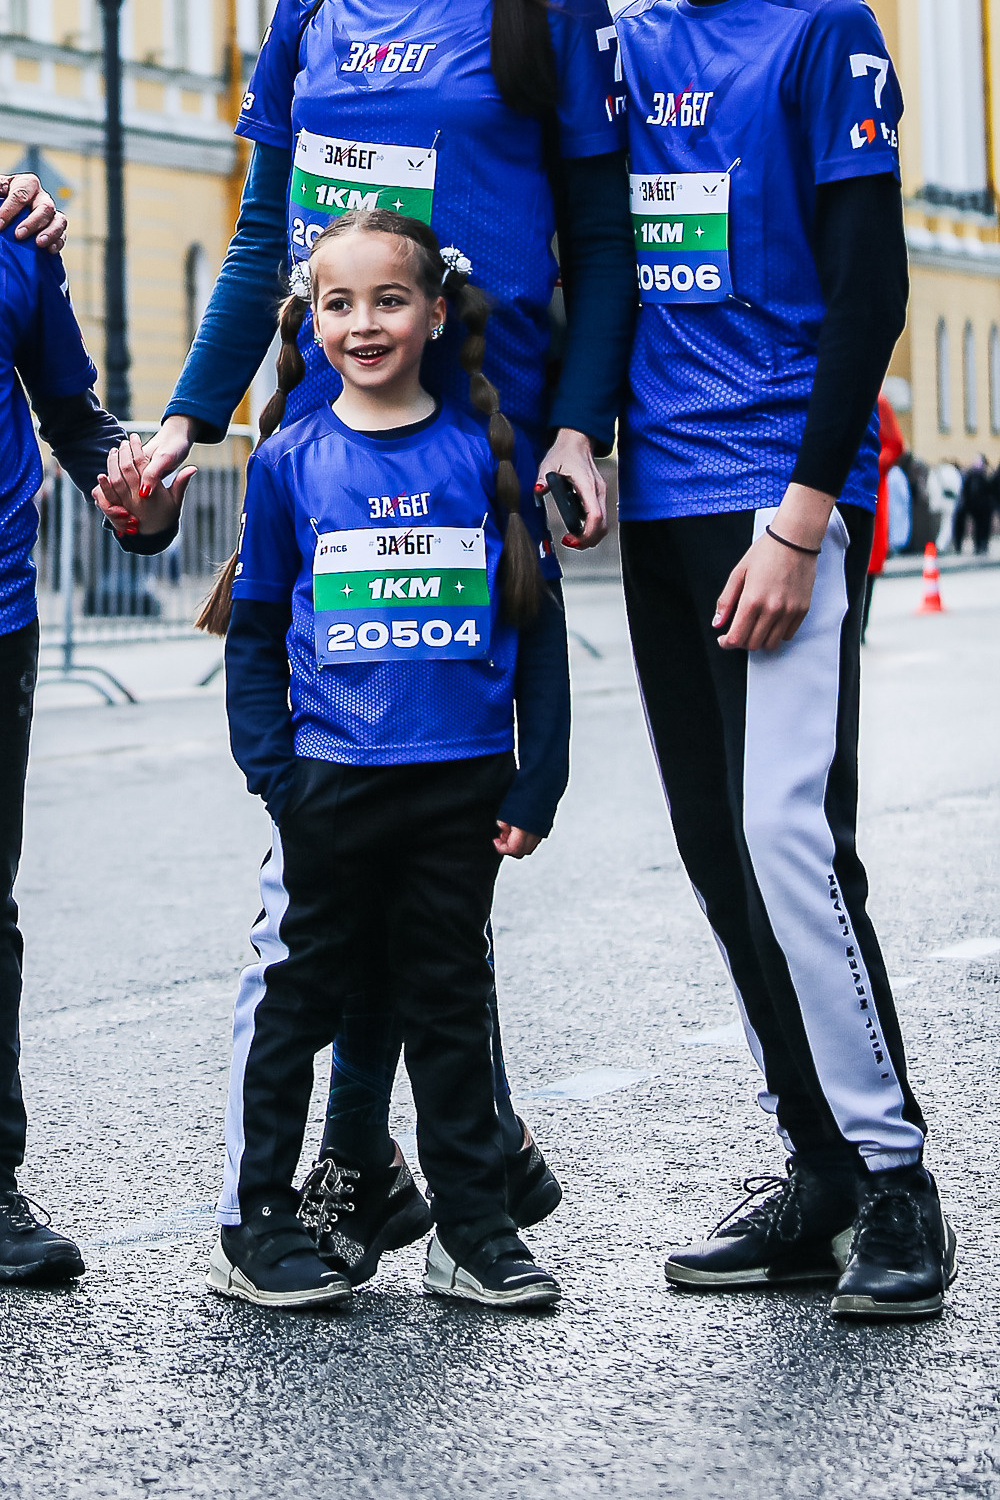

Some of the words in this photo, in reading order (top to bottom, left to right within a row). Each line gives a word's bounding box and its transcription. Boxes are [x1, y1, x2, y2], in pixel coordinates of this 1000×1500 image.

[849, 53, 889, 109] 7
[636, 264, 722, 292] 0506
[330, 545, 347, 553] ПСБ
[327, 619, 481, 652] 20504
[827, 873, 850, 937] LEARN
[845, 945, 869, 1011] NEVER
[865, 1017, 885, 1065] WILL
